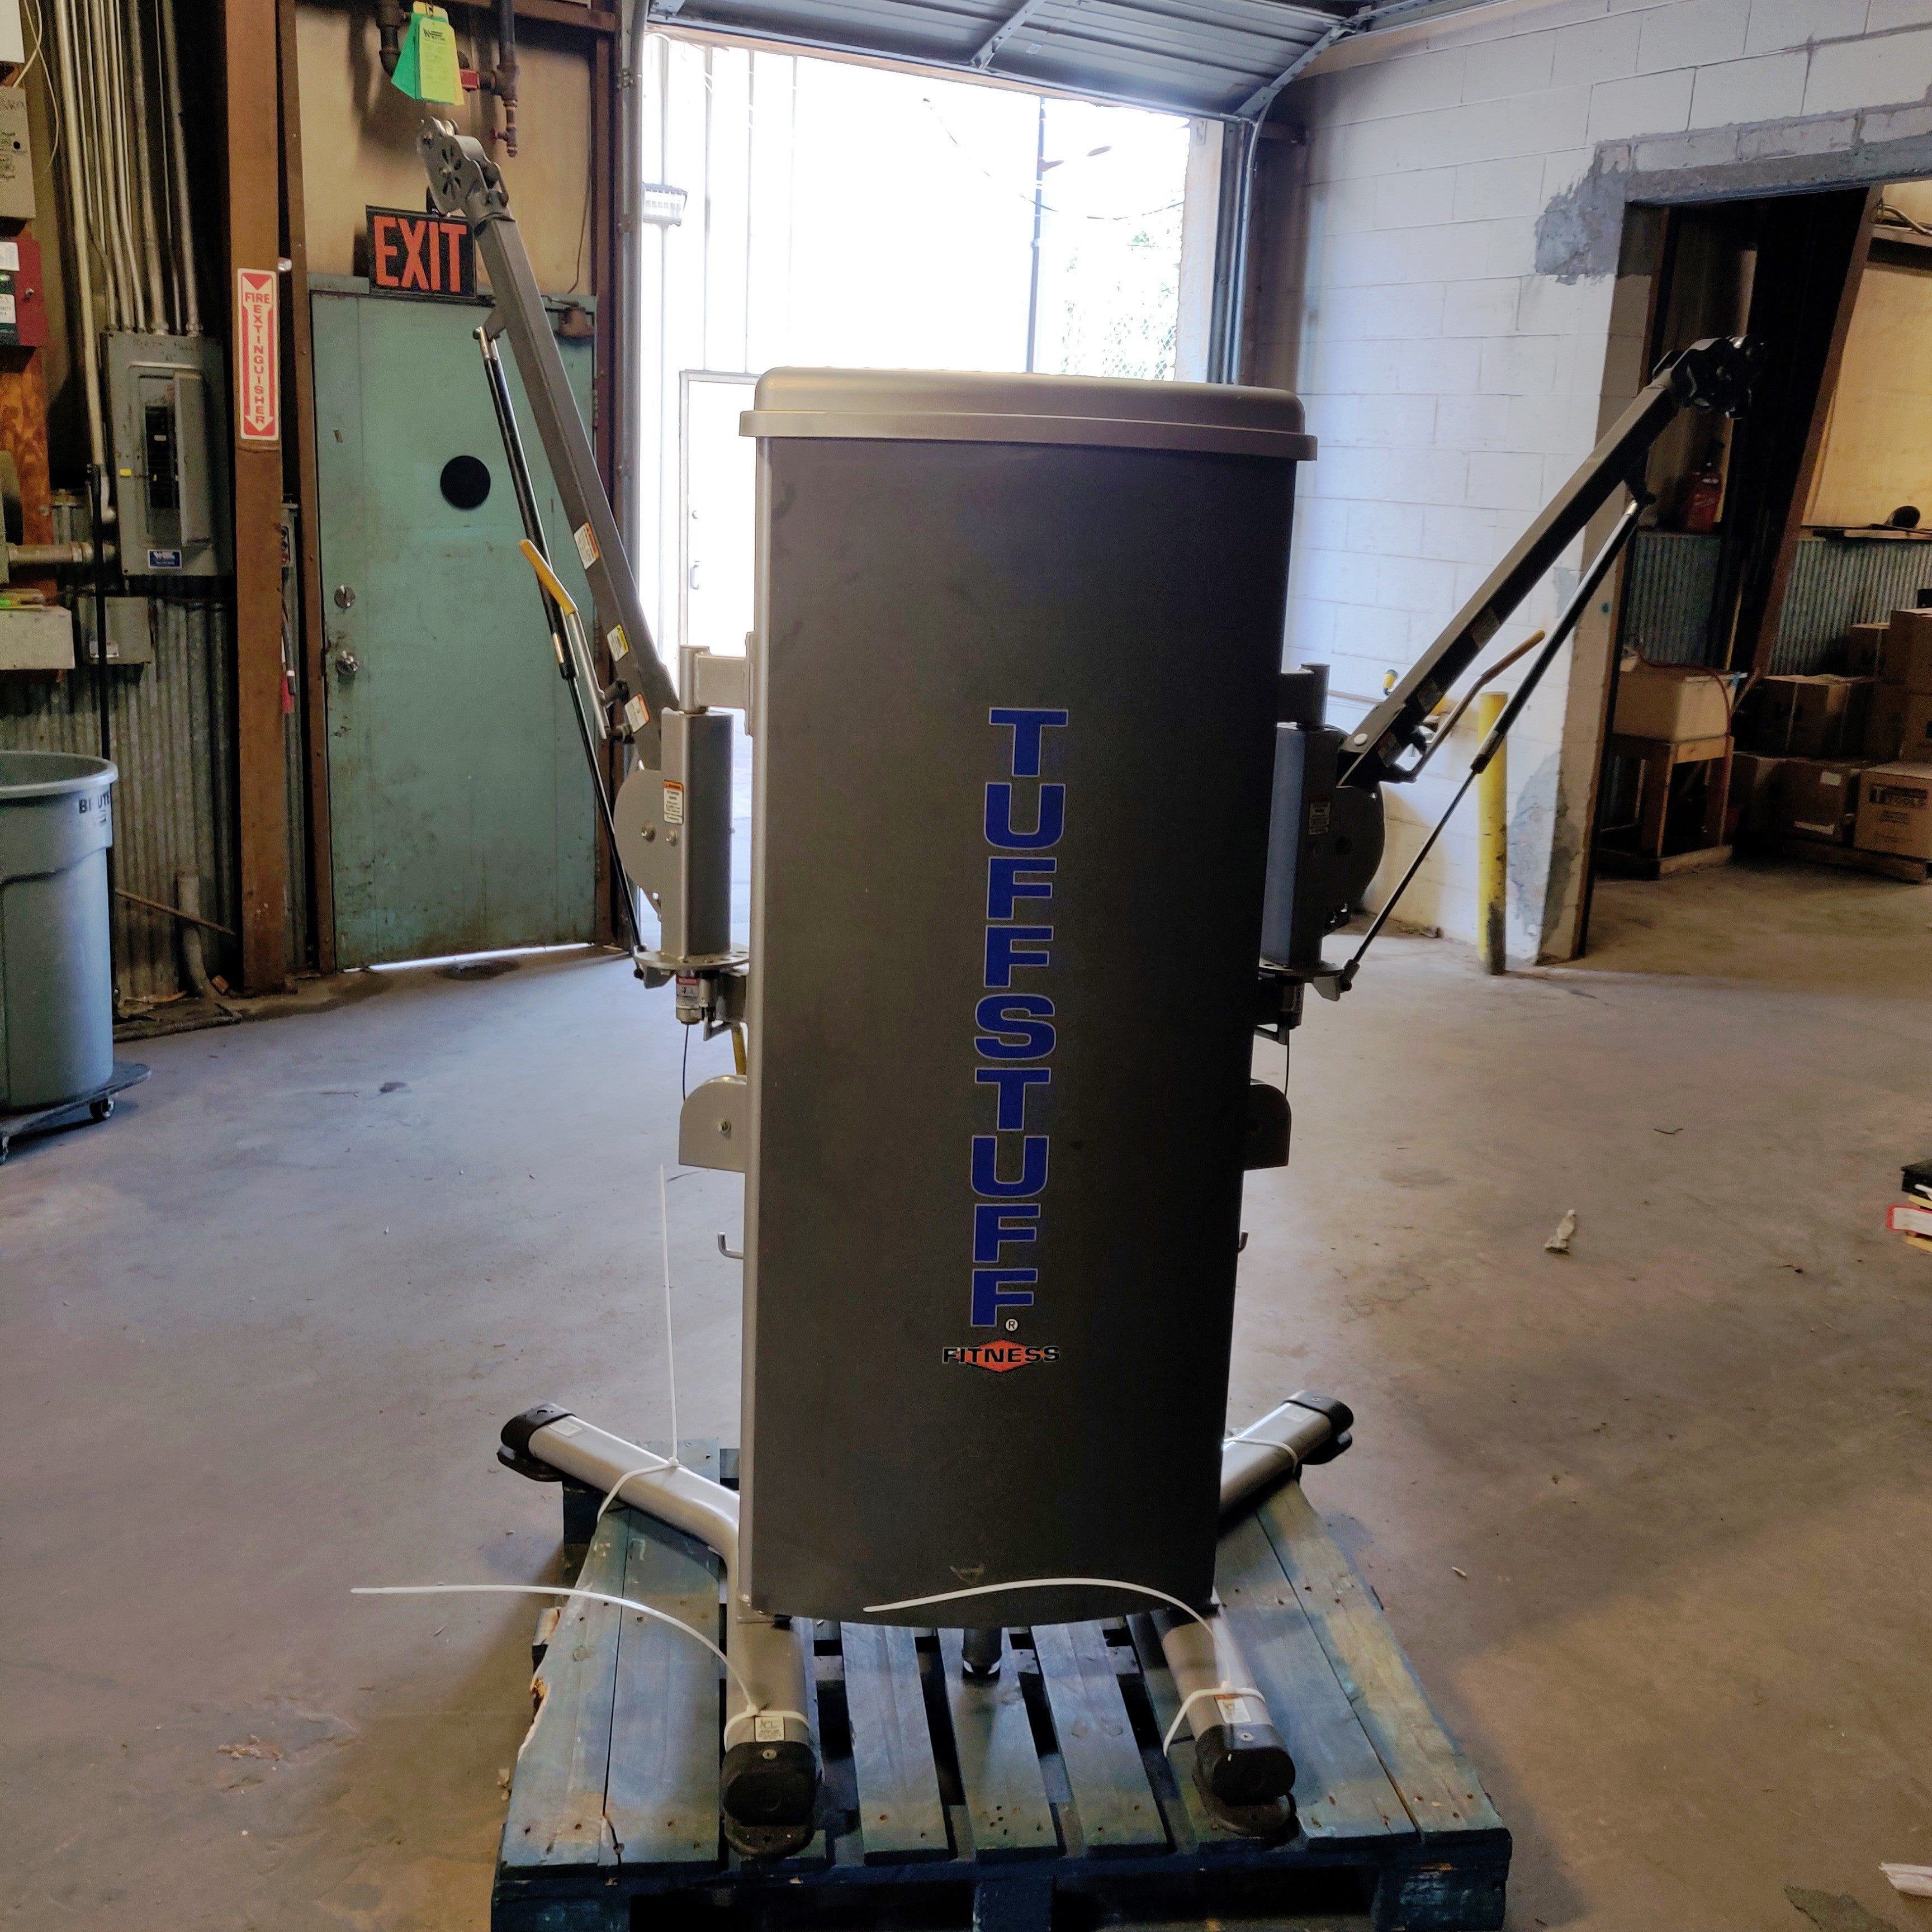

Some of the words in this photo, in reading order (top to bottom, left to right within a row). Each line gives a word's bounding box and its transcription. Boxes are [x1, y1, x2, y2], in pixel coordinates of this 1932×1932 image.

[373, 216, 467, 292] EXIT
[245, 292, 271, 304] FIRE
[253, 305, 264, 424] EXTINGUISHER
[970, 707, 1068, 1327] TUFFSTUFF
[943, 1346, 1060, 1363] FITNESS
